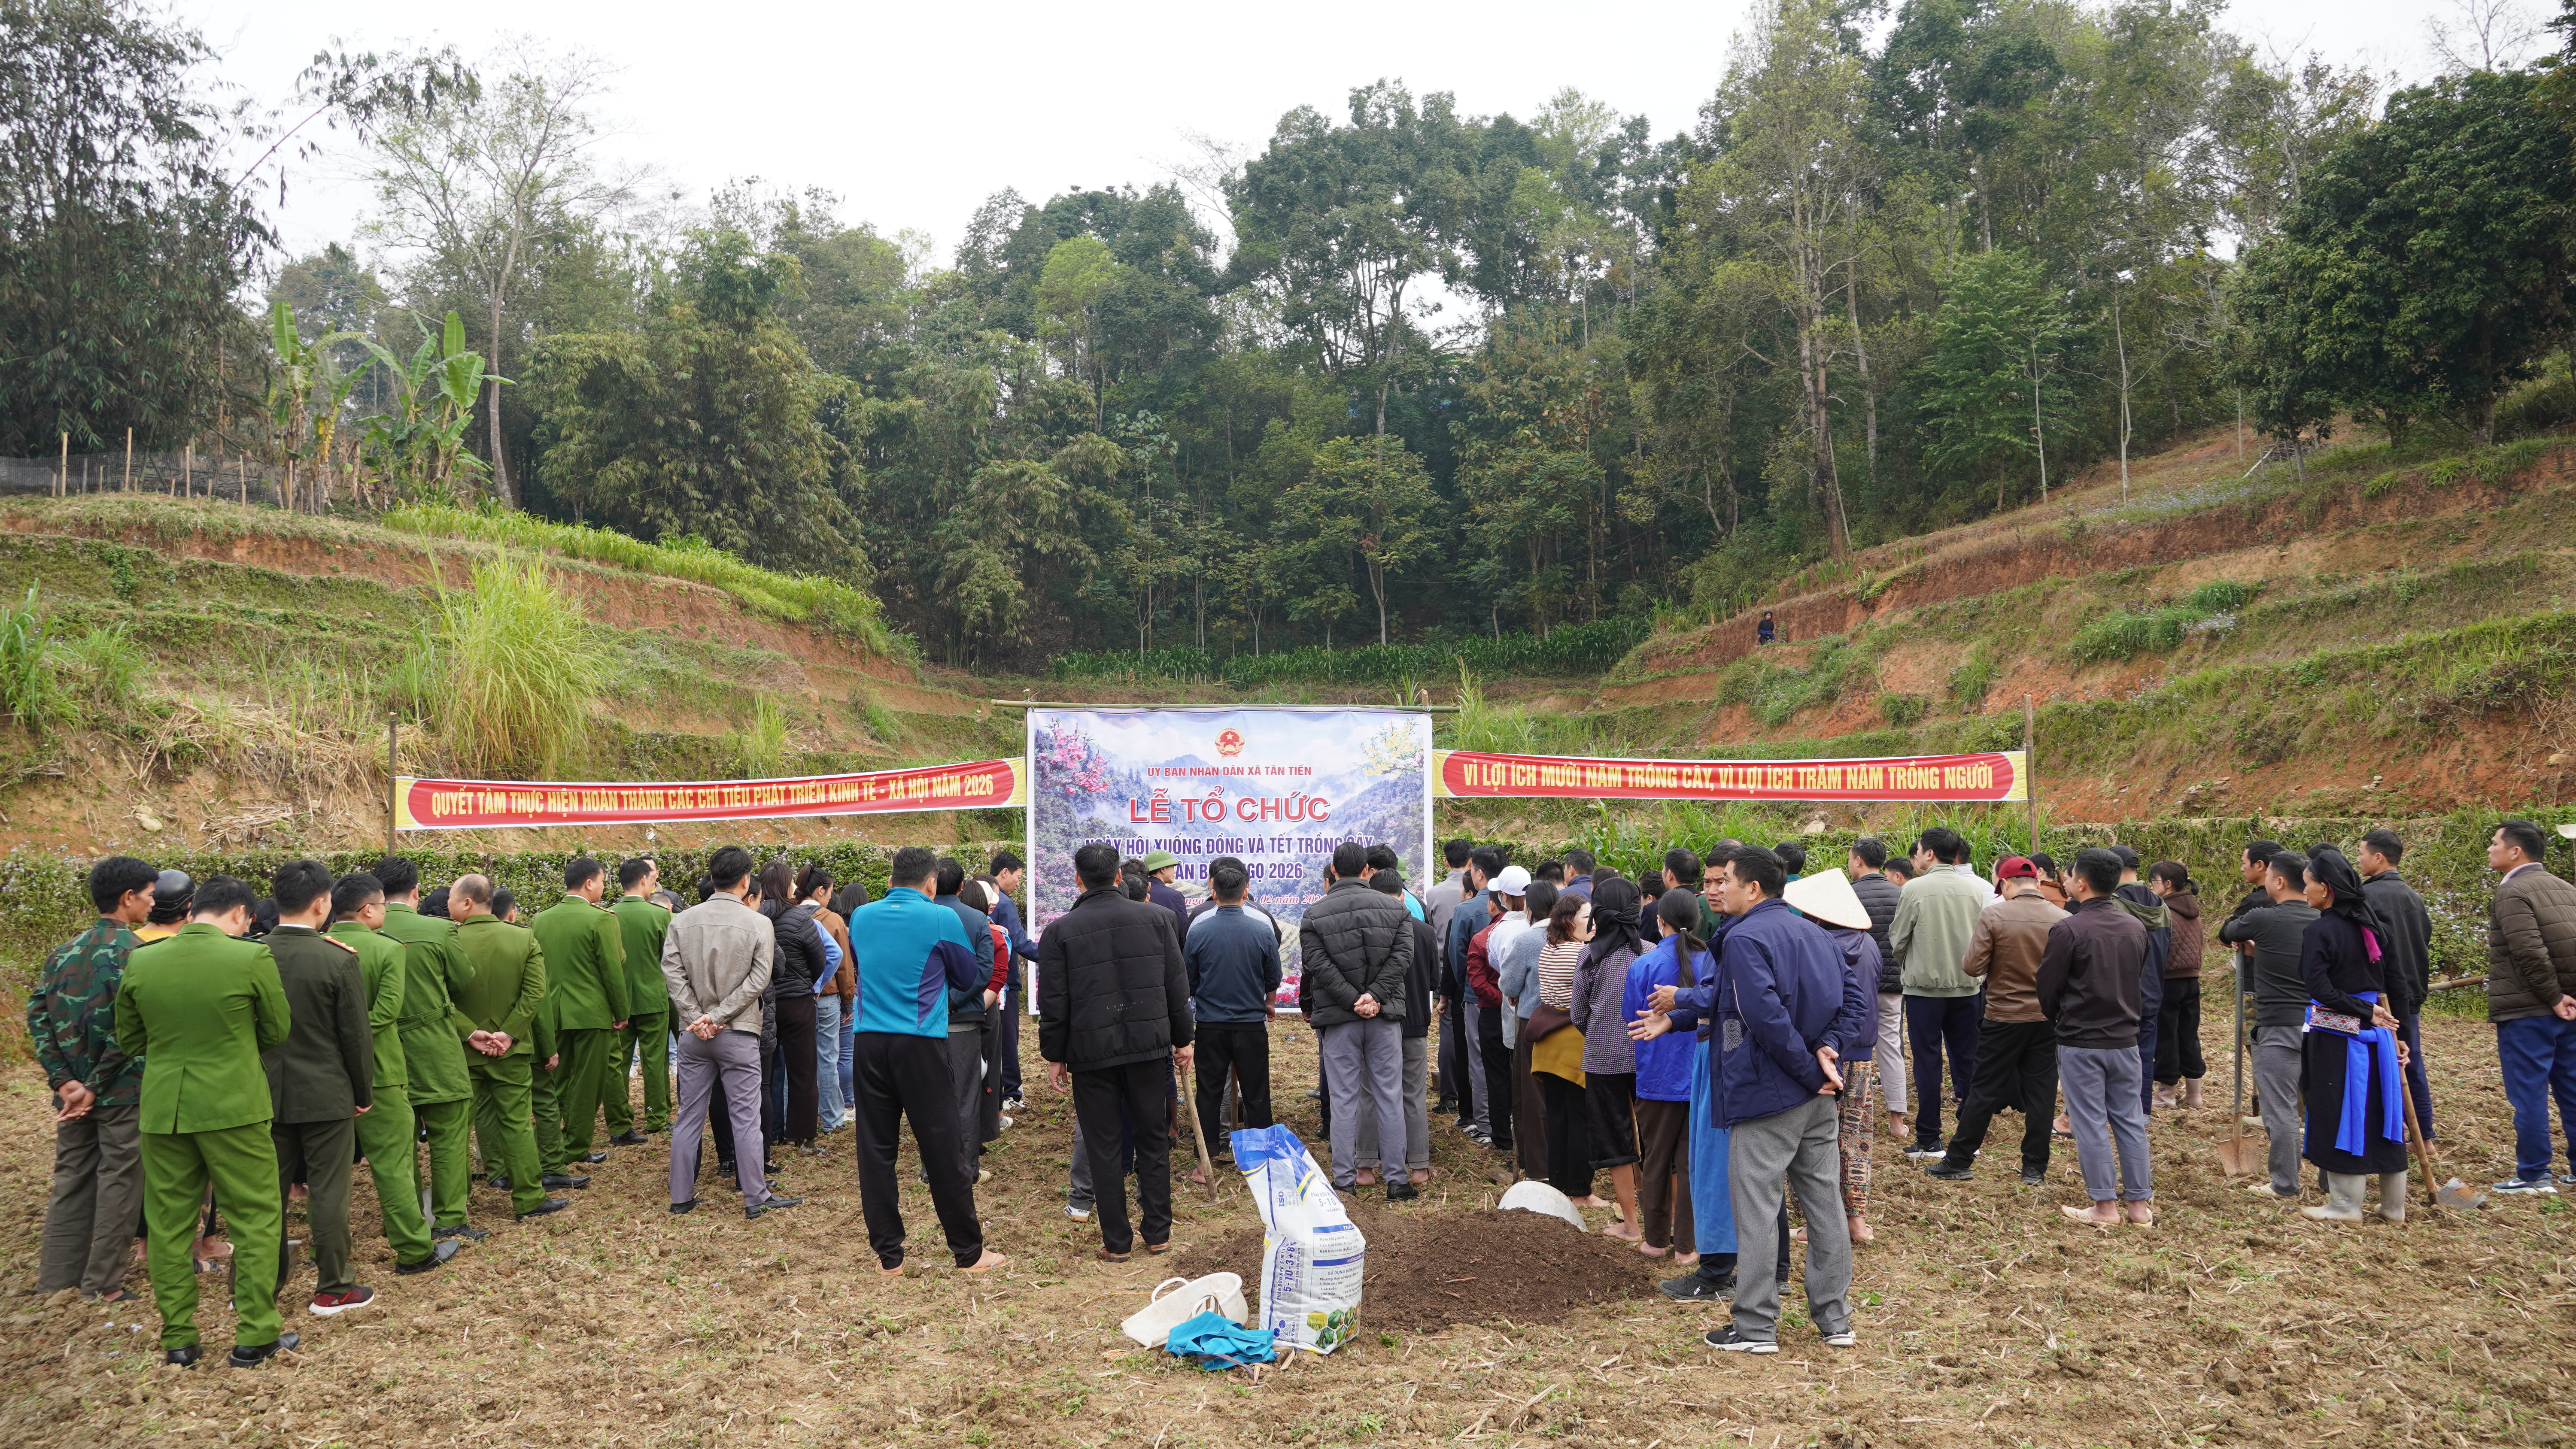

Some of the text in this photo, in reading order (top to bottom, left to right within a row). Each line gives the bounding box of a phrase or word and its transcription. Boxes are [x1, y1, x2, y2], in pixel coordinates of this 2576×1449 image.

[1148, 764, 1312, 776] ỦY BAN NHÂN DÂN XÃ TÂN TIẾN
[1463, 759, 1993, 794] VÌ LỢI ÍCH MƯỜI NĂM TRỒNG CÂY, VÌ LỢI ÍCH TRĂM NĂM TRỒNG NGƯỜI
[431, 785, 474, 818] QUYẾT
[477, 788, 506, 814] TÂM
[511, 789, 544, 818] THỰC
[547, 788, 579, 817] HIỆN
[582, 789, 619, 811] HOÀN
[622, 788, 664, 810] THÀNH
[668, 787, 694, 809] CÁC
[698, 786, 719, 808] CHỈ
[723, 785, 750, 807] TIÊU
[753, 783, 787, 806] PHÁT
[789, 780, 826, 804] TRIỂN
[829, 782, 859, 803] KINH
[862, 776, 877, 801] TẾ
[888, 776, 906, 800] XÃ
[908, 775, 930, 803] HỘI
[931, 772, 961, 798] NĂM
[964, 774, 994, 796] 2026
[1130, 785, 1330, 822] LỄ TỔ CHỨC
[1126, 836, 1149, 858] HỘI
[1154, 833, 1201, 854] XUỐNG
[1206, 832, 1243, 854] ĐỒNG
[1249, 834, 1267, 853] VÀ
[1270, 833, 1292, 853] TẾT
[1244, 863, 1264, 882] GỌ
[1269, 863, 1302, 878] 2026
[1261, 895, 1273, 904] 02
[1276, 895, 1299, 904] năm
